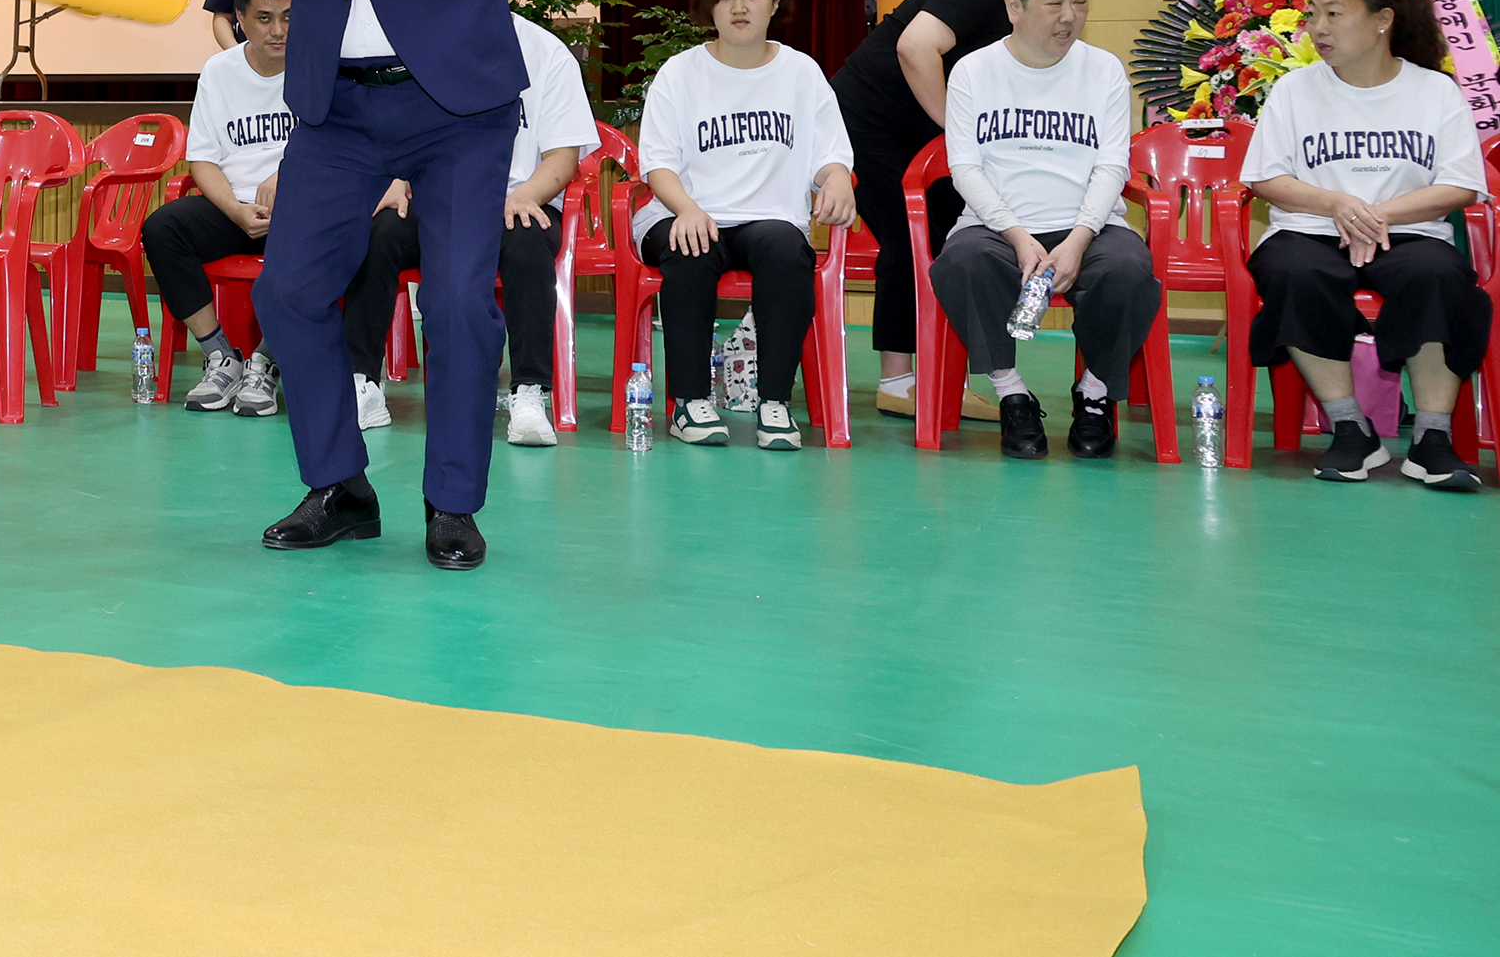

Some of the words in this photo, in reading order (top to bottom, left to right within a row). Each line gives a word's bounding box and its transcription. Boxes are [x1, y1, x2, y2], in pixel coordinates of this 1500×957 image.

[226, 112, 299, 147] CALIFOR
[697, 110, 795, 153] CALIFORNIA
[976, 108, 1099, 150] CALIFORNIA
[1302, 130, 1435, 171] CALIFORNIA
